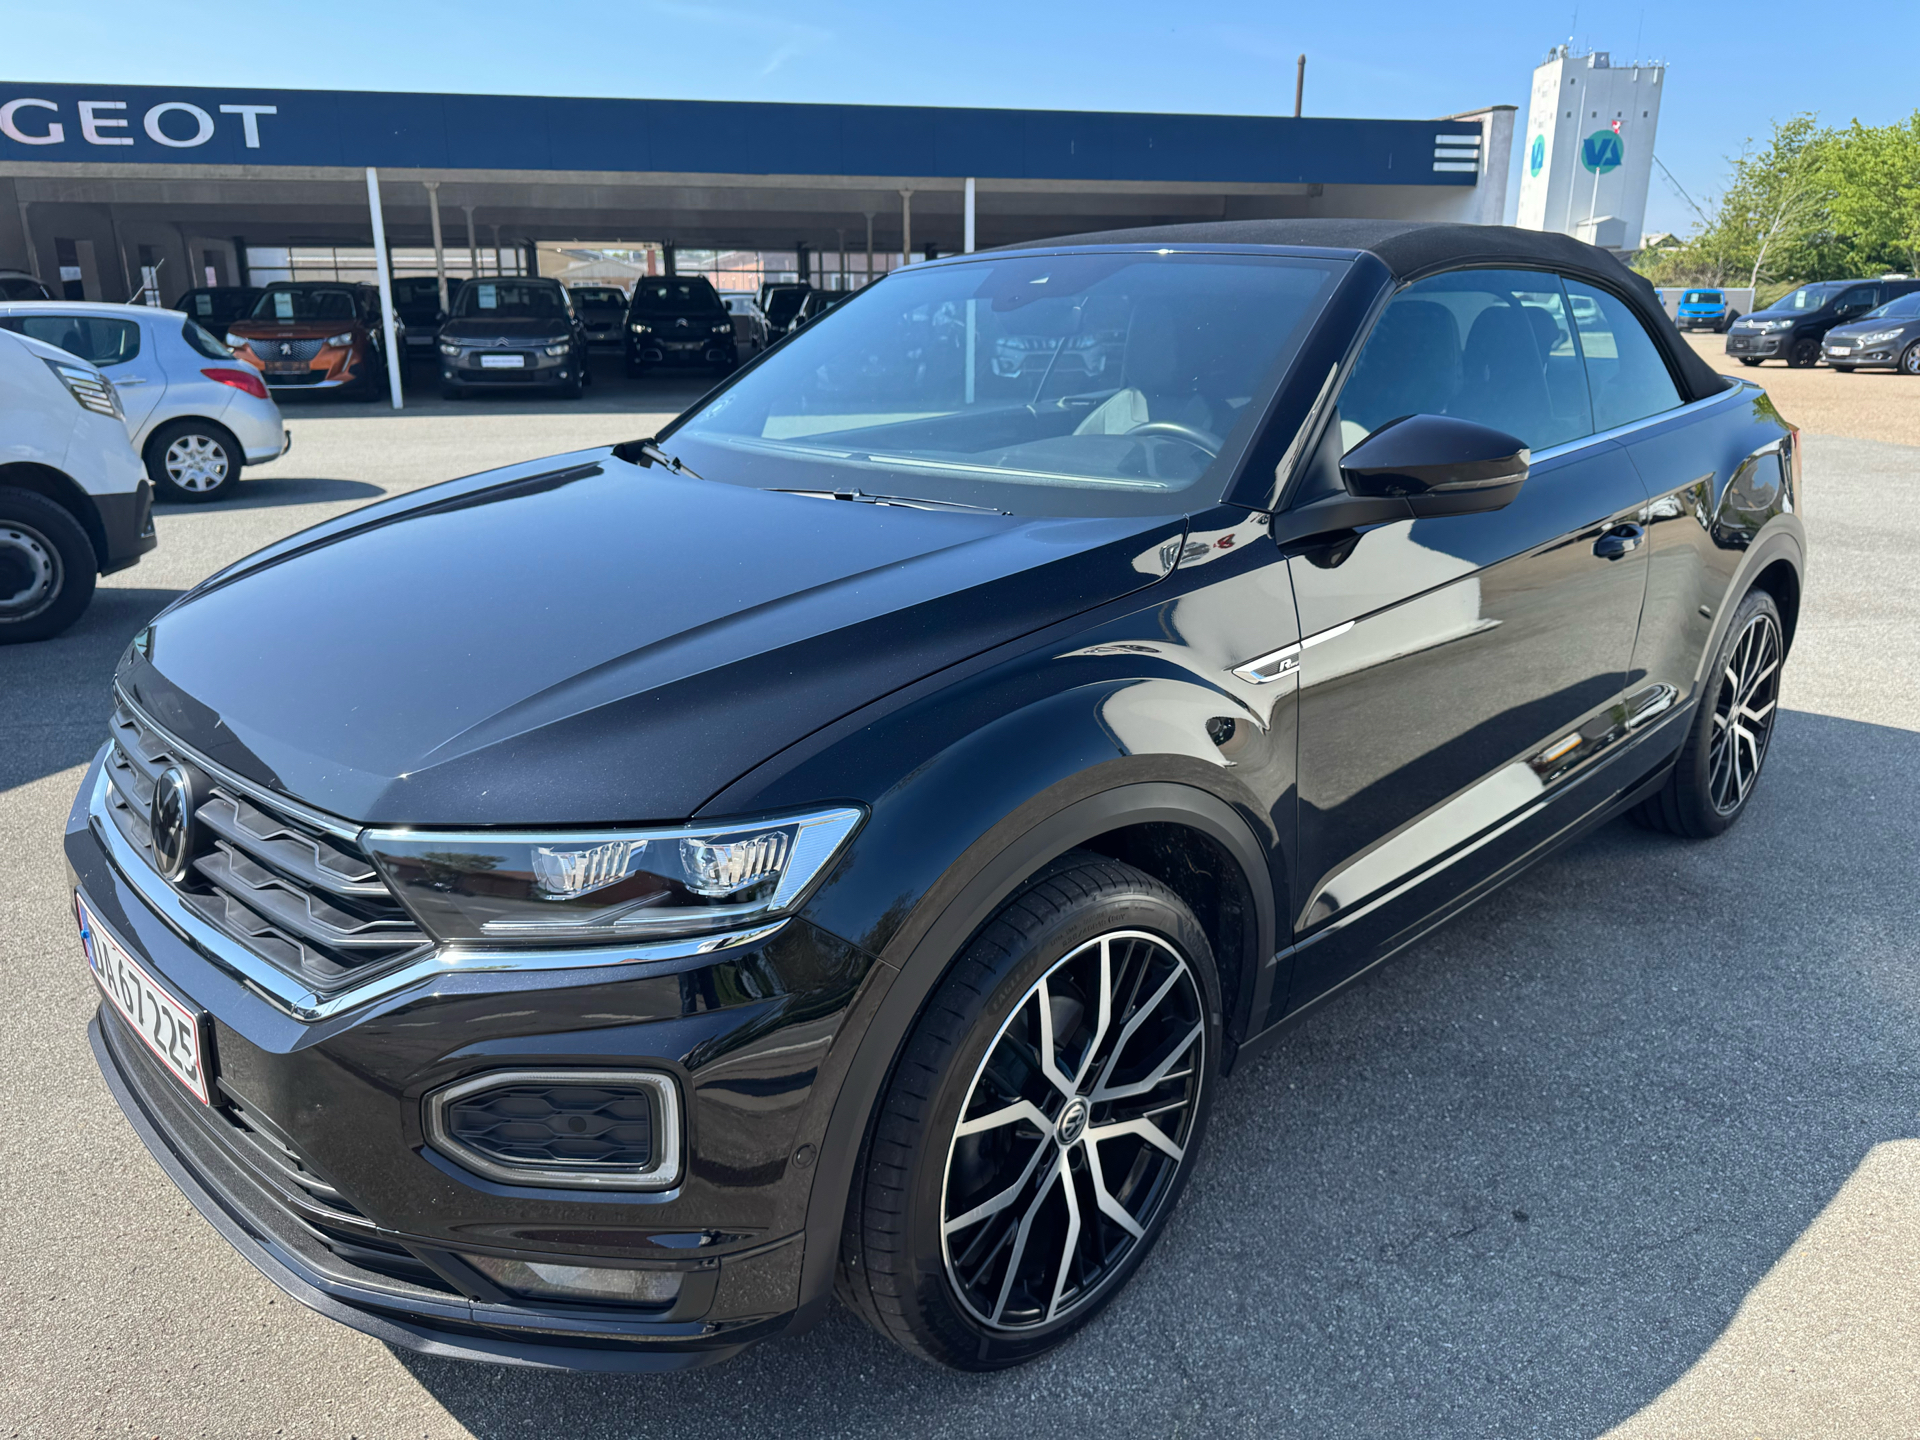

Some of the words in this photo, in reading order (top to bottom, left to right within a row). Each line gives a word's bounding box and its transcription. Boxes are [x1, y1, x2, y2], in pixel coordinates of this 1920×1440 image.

[0, 98, 278, 149] GEOT
[1583, 138, 1622, 166] VA
[118, 958, 144, 1026] 67
[146, 988, 198, 1083] 225
